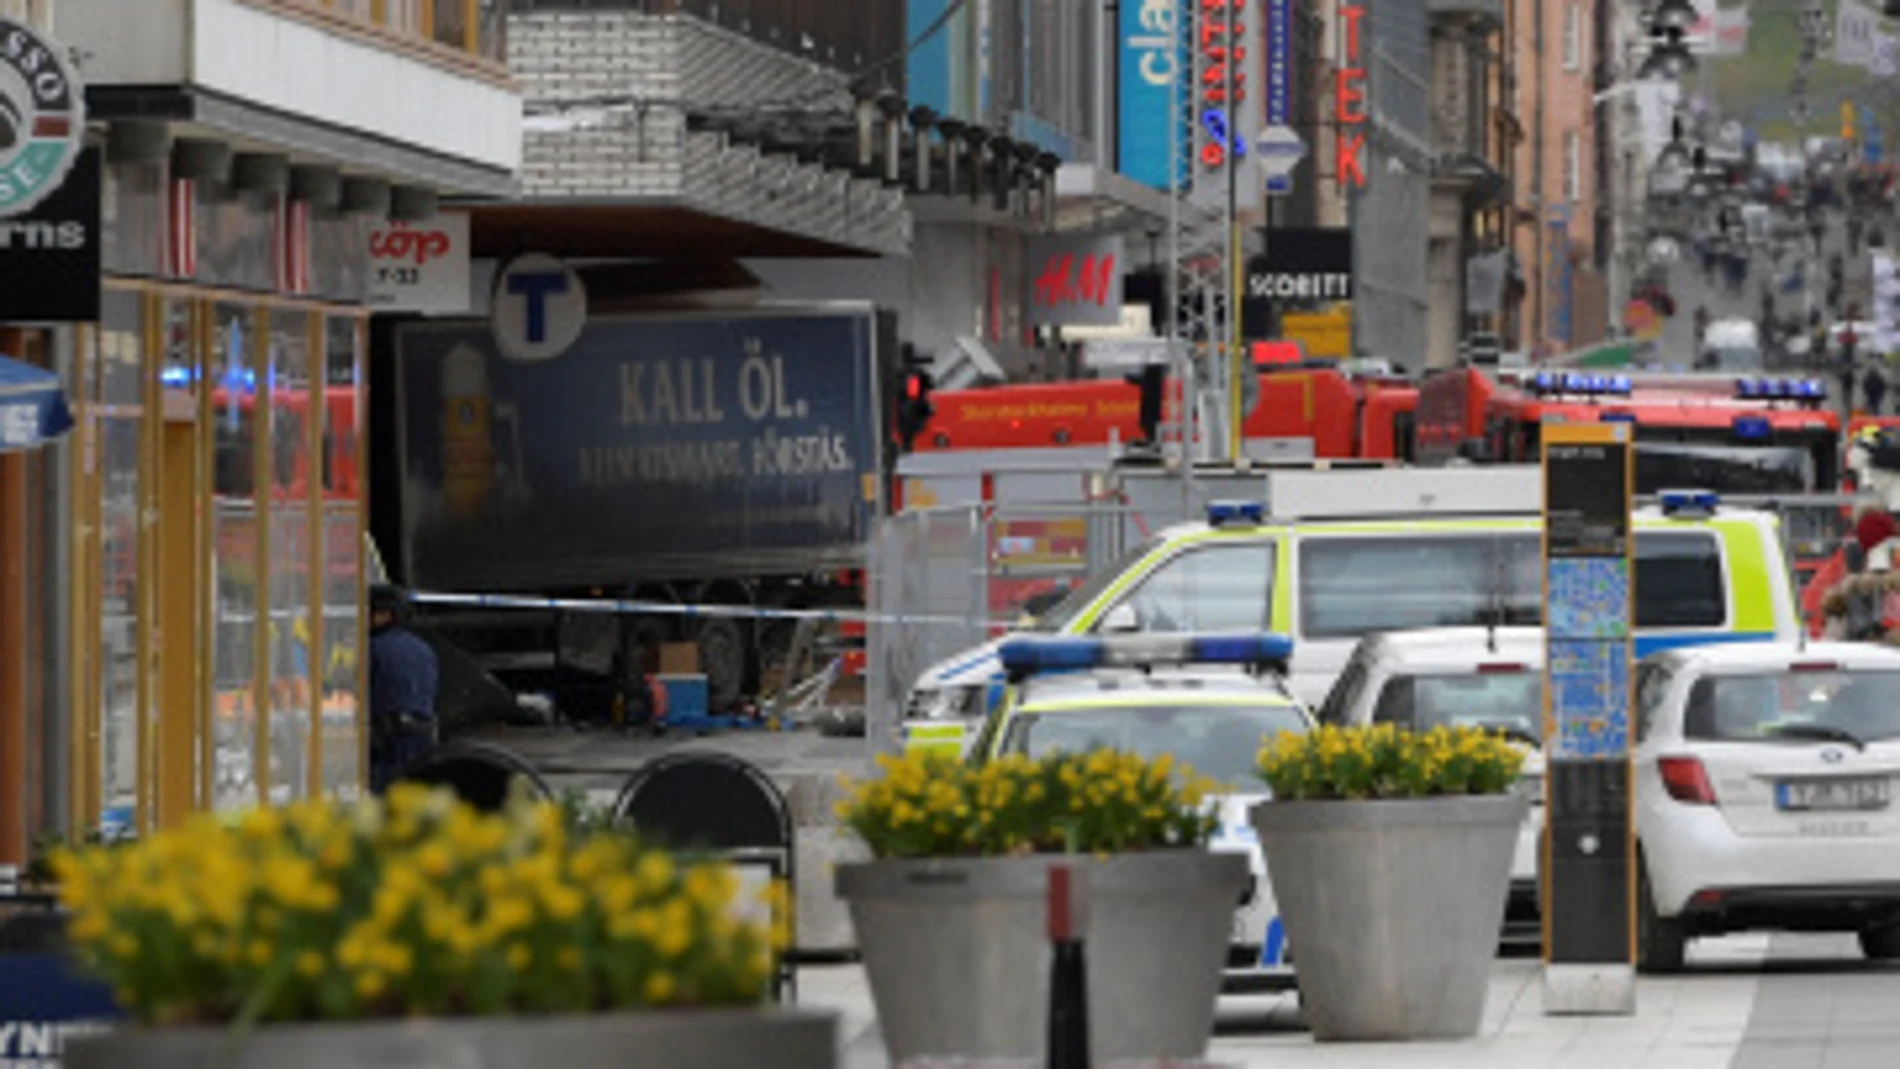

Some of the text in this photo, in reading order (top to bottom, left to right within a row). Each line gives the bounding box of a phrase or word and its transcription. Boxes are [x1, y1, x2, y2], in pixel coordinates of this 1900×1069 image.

[506, 272, 569, 343] T
[618, 336, 809, 427] KALL ÖL.
